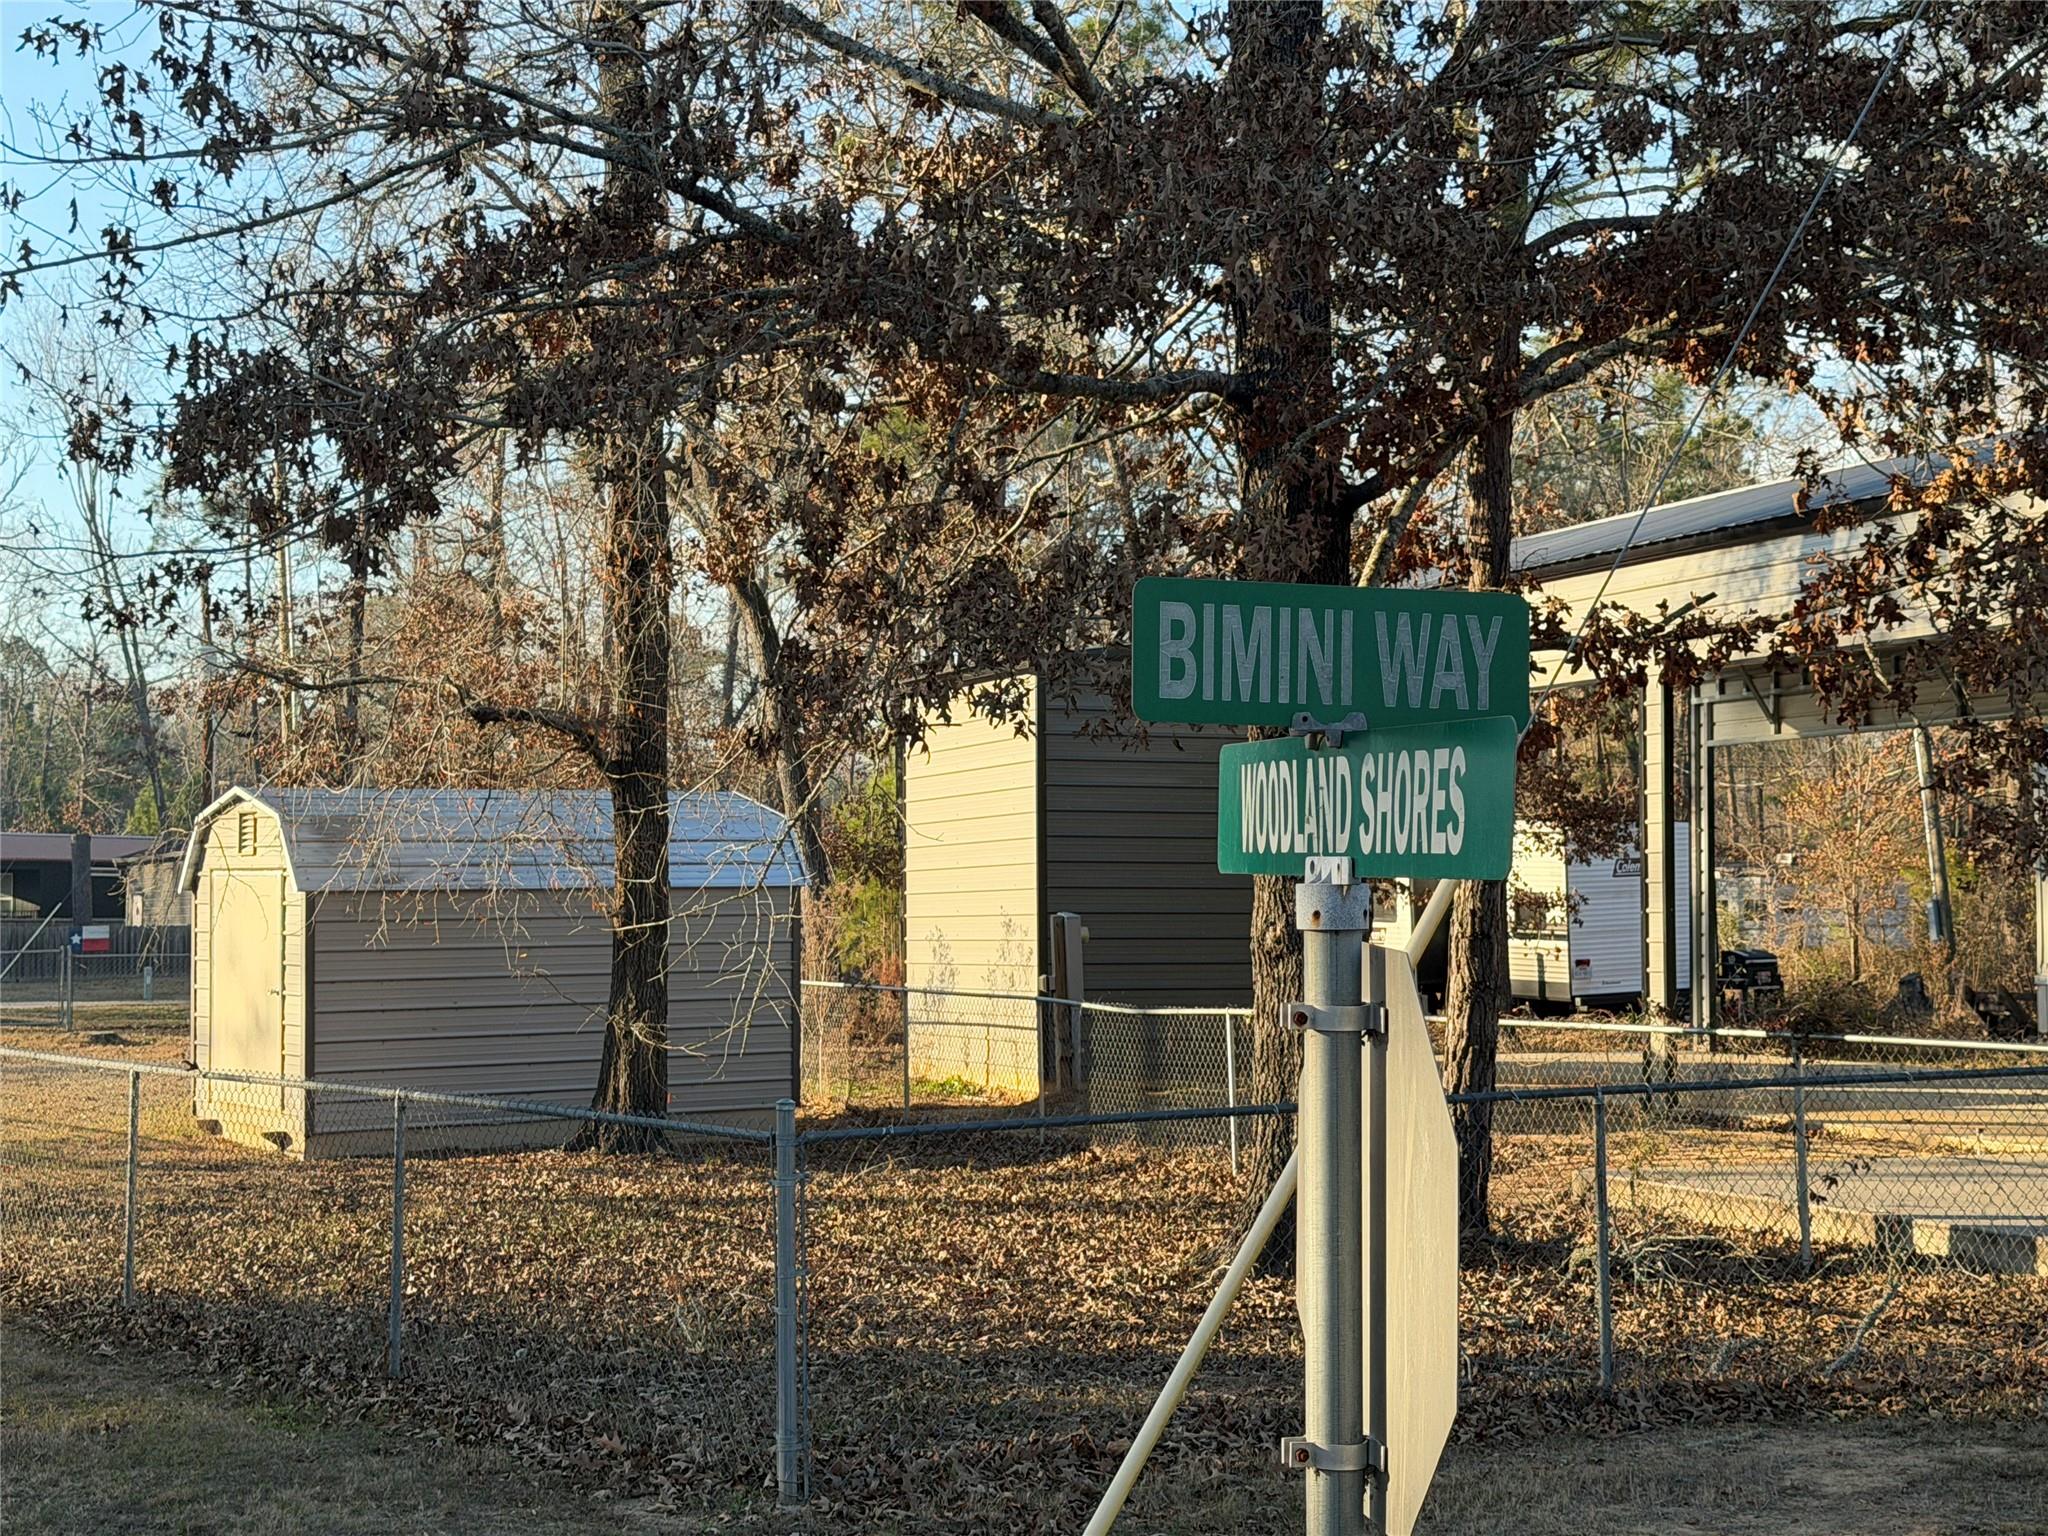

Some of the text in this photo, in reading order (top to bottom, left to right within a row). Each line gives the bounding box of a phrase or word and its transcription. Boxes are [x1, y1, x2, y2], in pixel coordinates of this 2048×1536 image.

[1159, 601, 1503, 711] BIMINI WAY
[1241, 746, 1466, 856] WOODLAND SHORES
